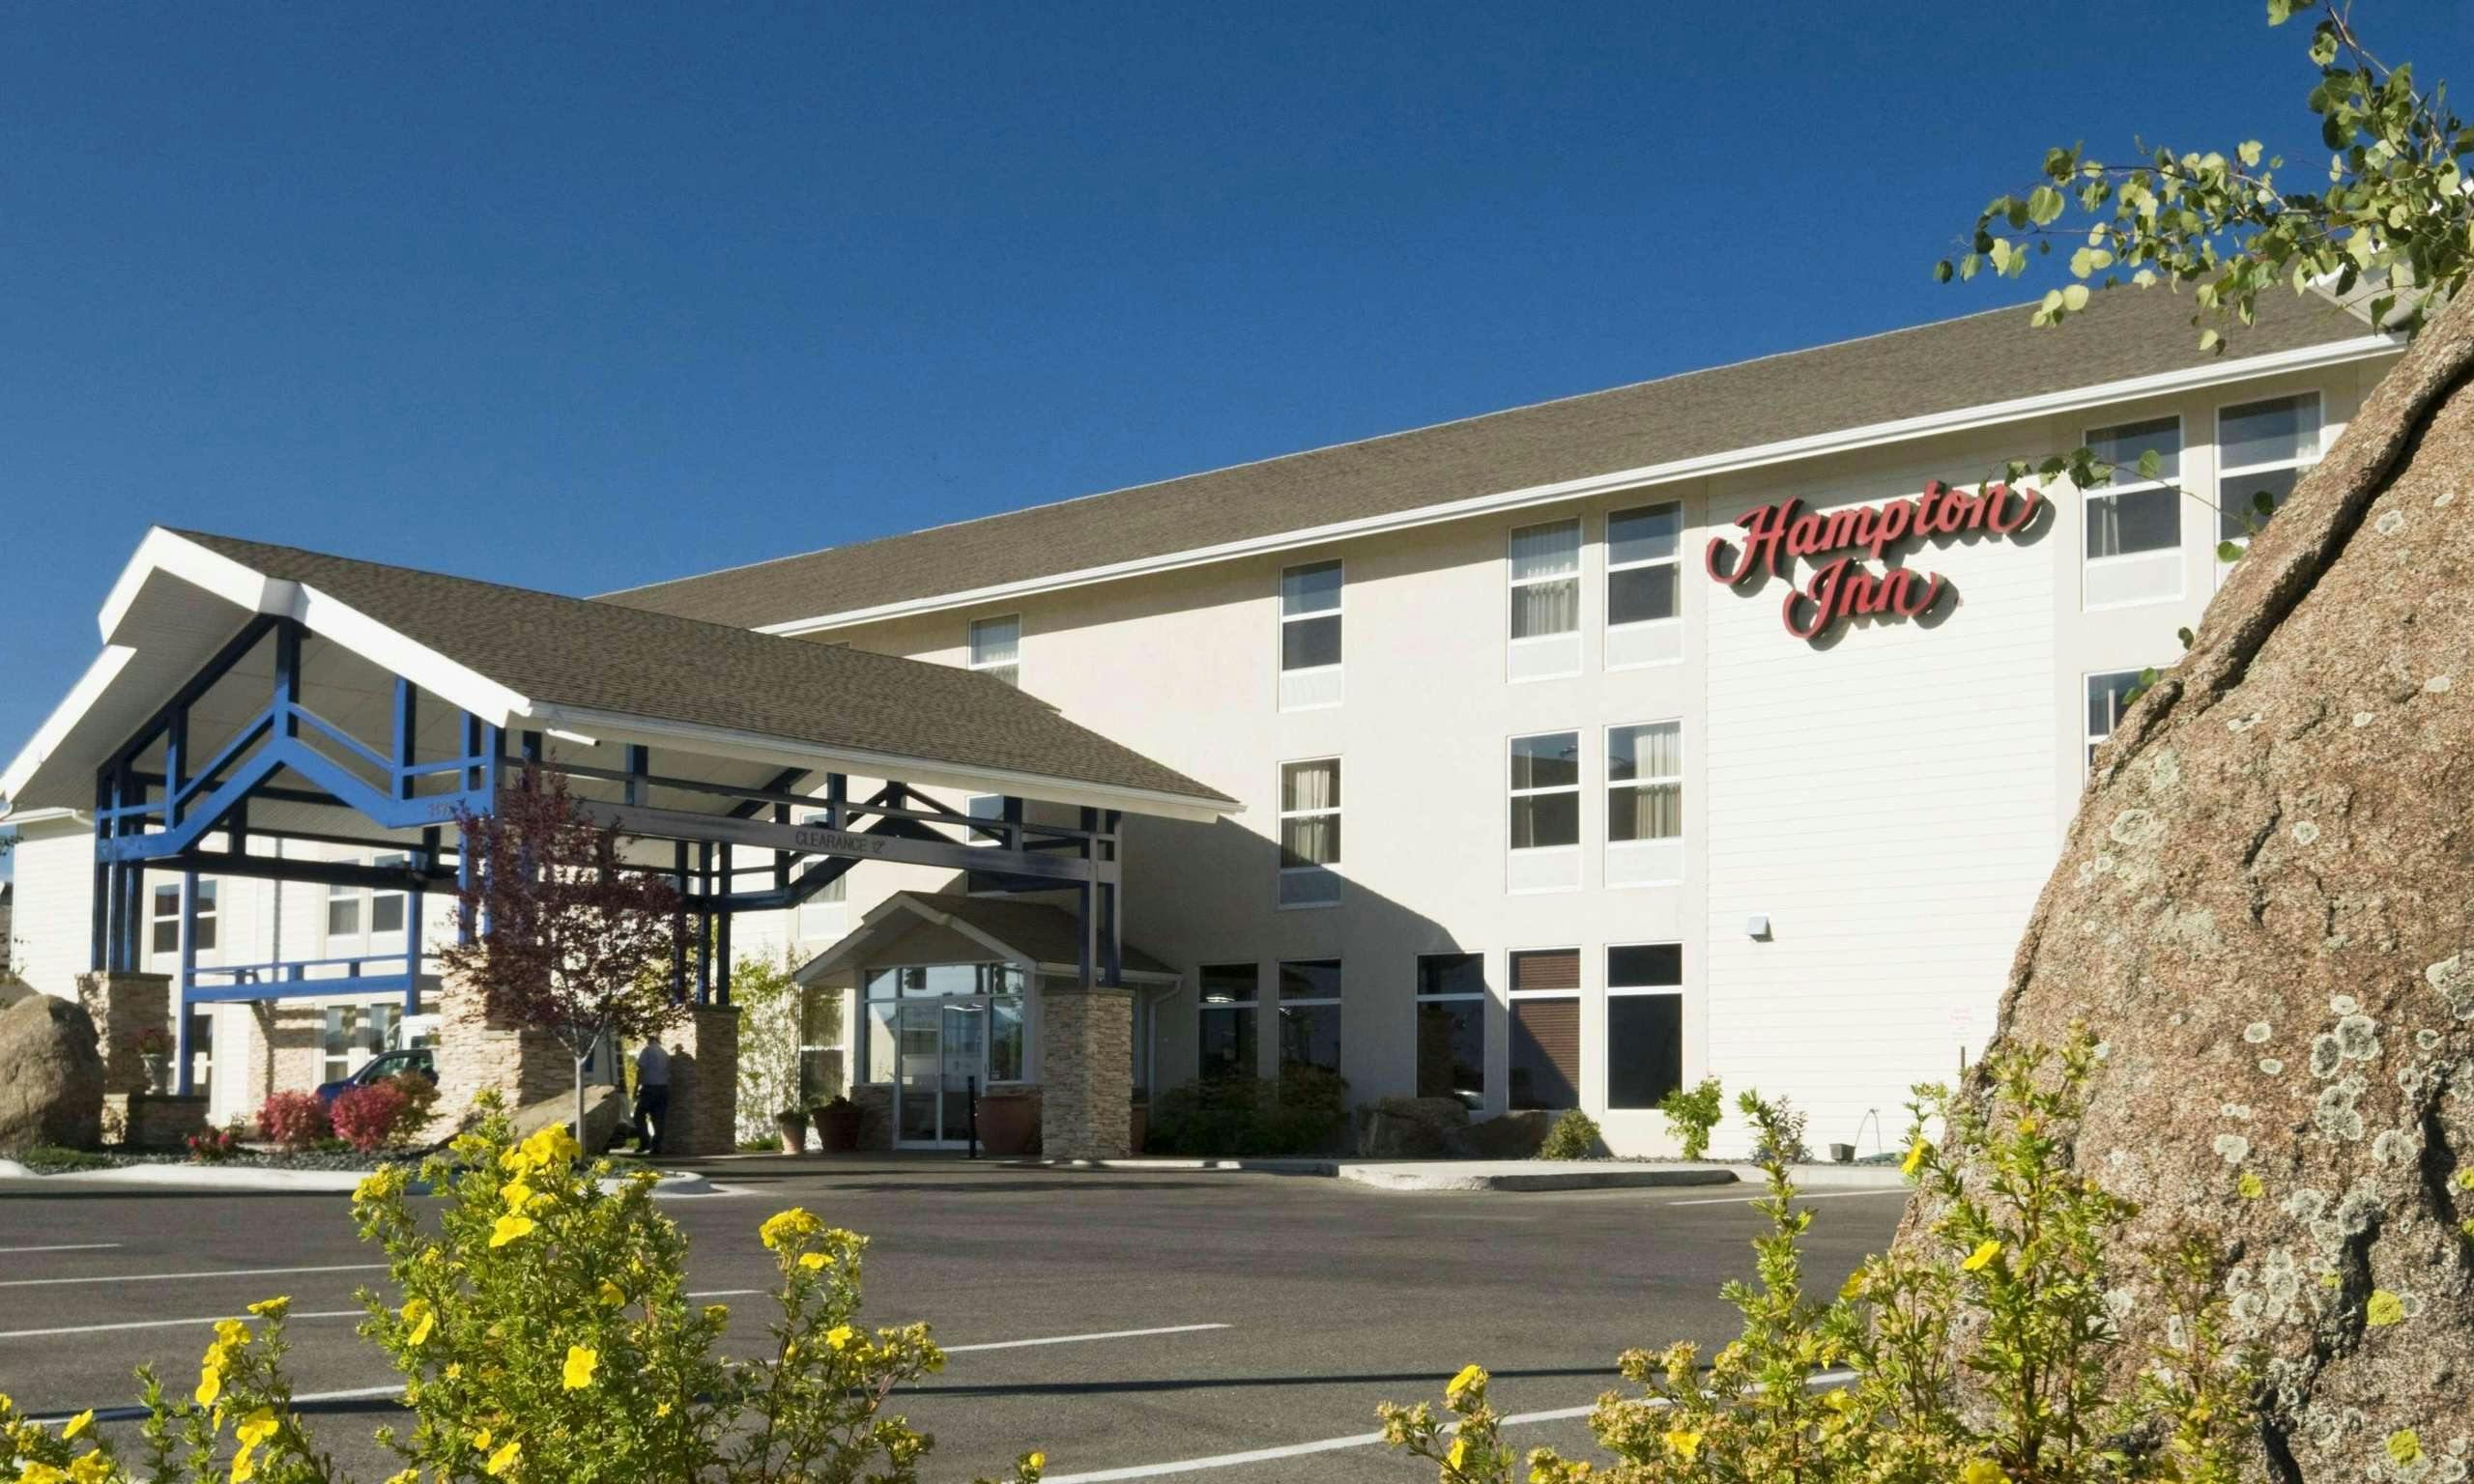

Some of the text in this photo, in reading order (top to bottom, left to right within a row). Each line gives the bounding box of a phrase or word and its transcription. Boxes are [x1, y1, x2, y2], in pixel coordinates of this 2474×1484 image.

[1706, 479, 2041, 585] Hampton
[1783, 557, 1939, 640] Inn
[795, 830, 867, 851] CLEARANCE
